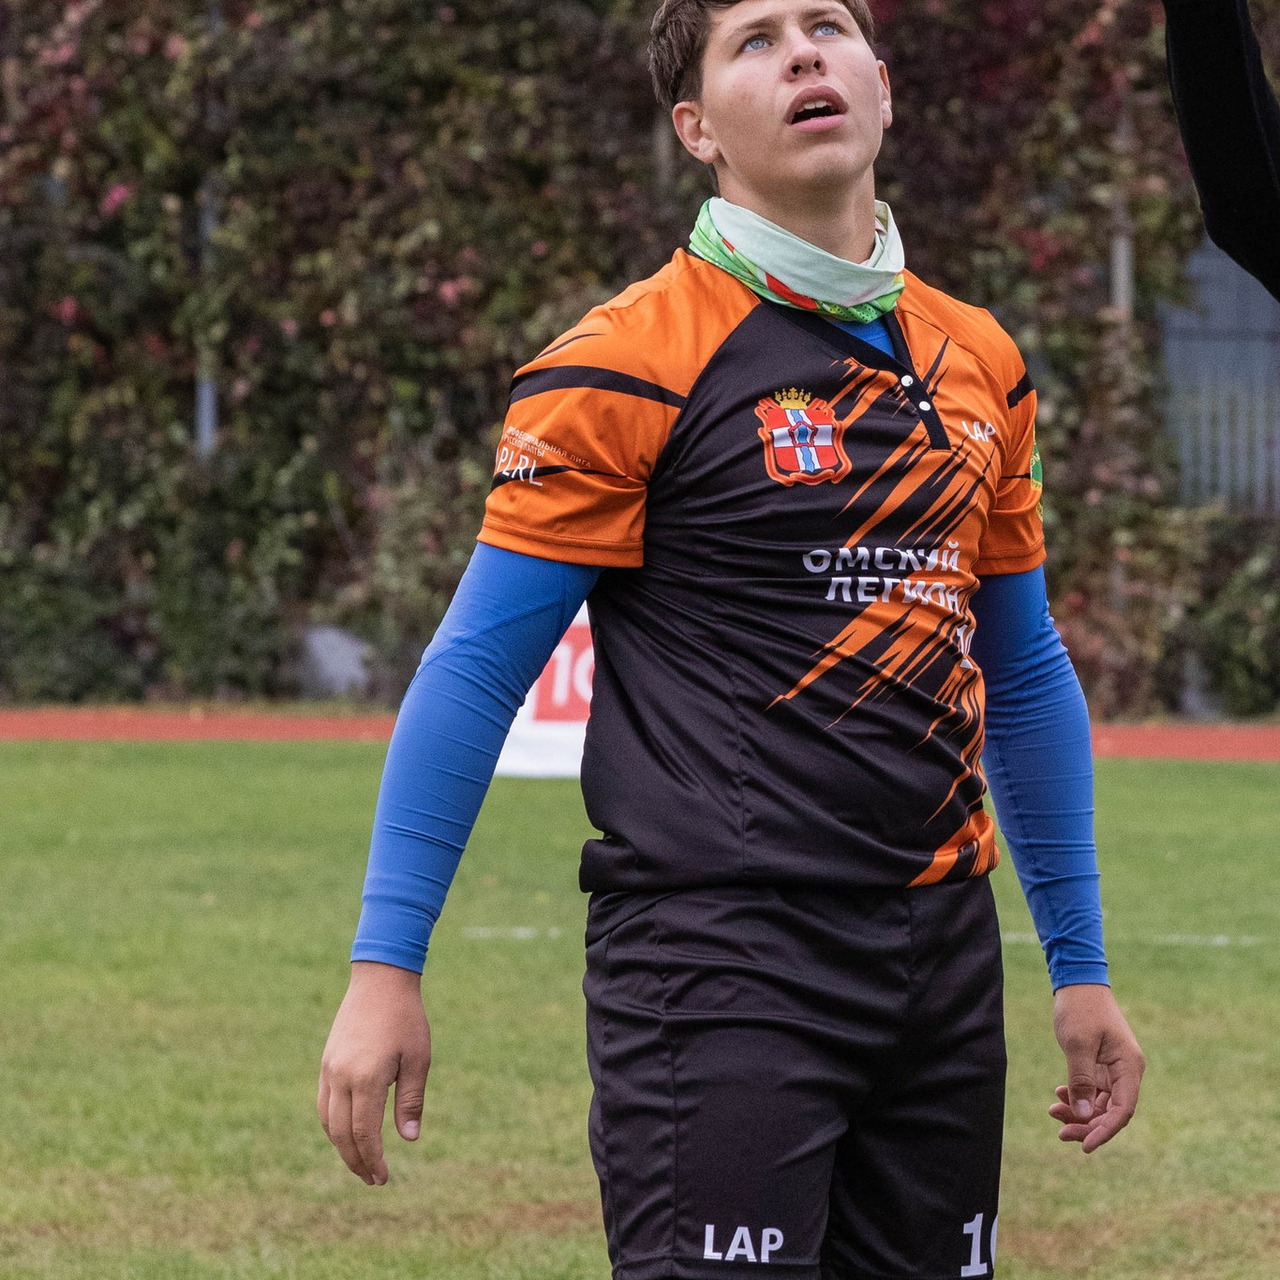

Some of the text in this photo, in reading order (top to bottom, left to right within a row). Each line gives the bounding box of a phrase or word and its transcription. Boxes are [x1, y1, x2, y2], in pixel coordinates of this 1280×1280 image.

[961, 420, 996, 442] LAP
[496, 445, 544, 487] PLRL
[802, 541, 960, 573] ОМСКИЙ
[824, 576, 964, 616] ЛЕГИОН
[703, 1224, 784, 1263] LAP
[960, 1213, 998, 1278] 1
